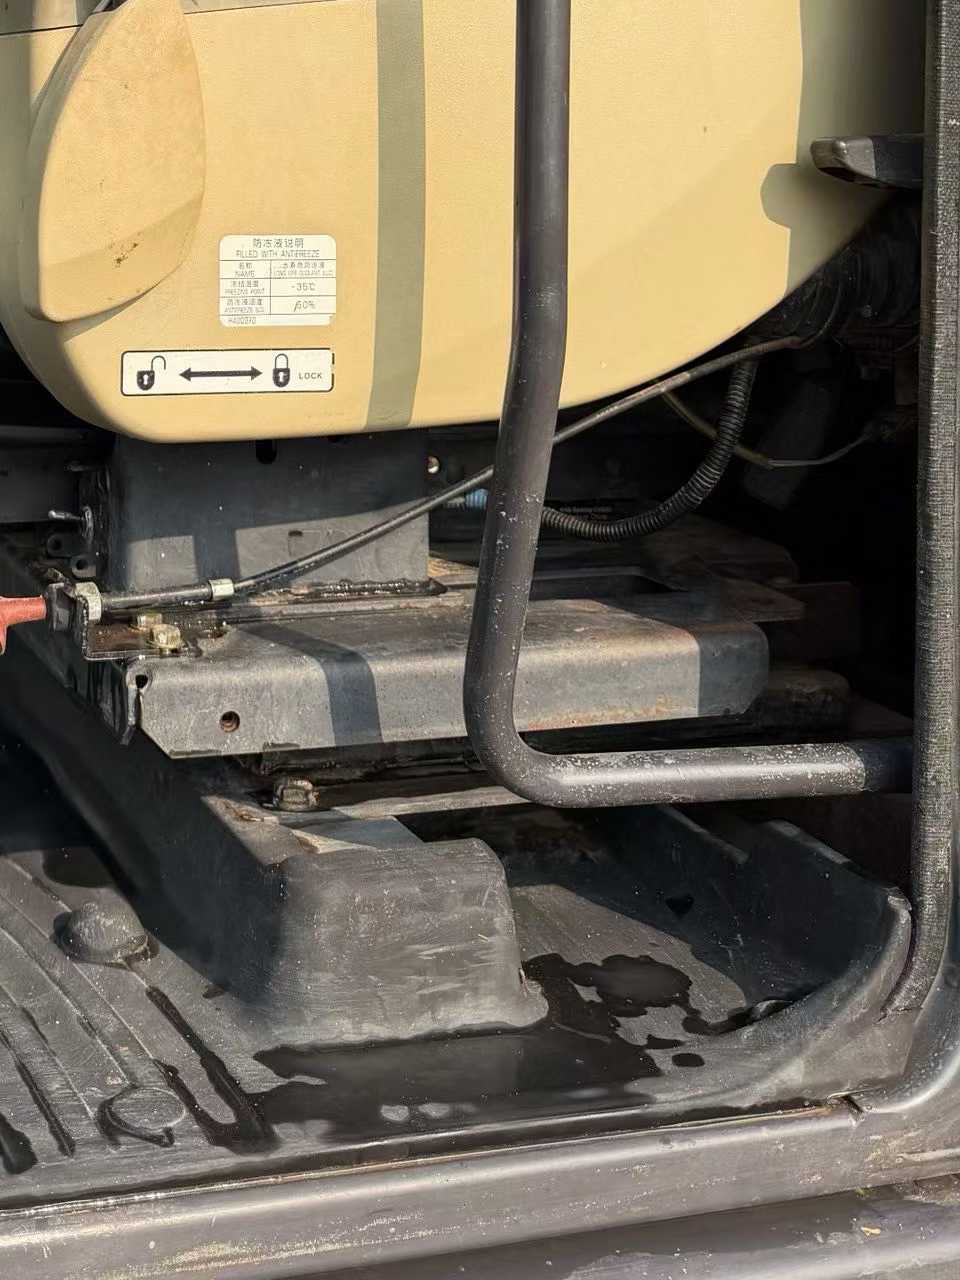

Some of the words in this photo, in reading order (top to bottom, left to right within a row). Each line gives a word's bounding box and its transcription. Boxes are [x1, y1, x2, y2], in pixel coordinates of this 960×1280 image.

[252, 238, 304, 248] 防冻液说明
[298, 372, 322, 380] LOCK
